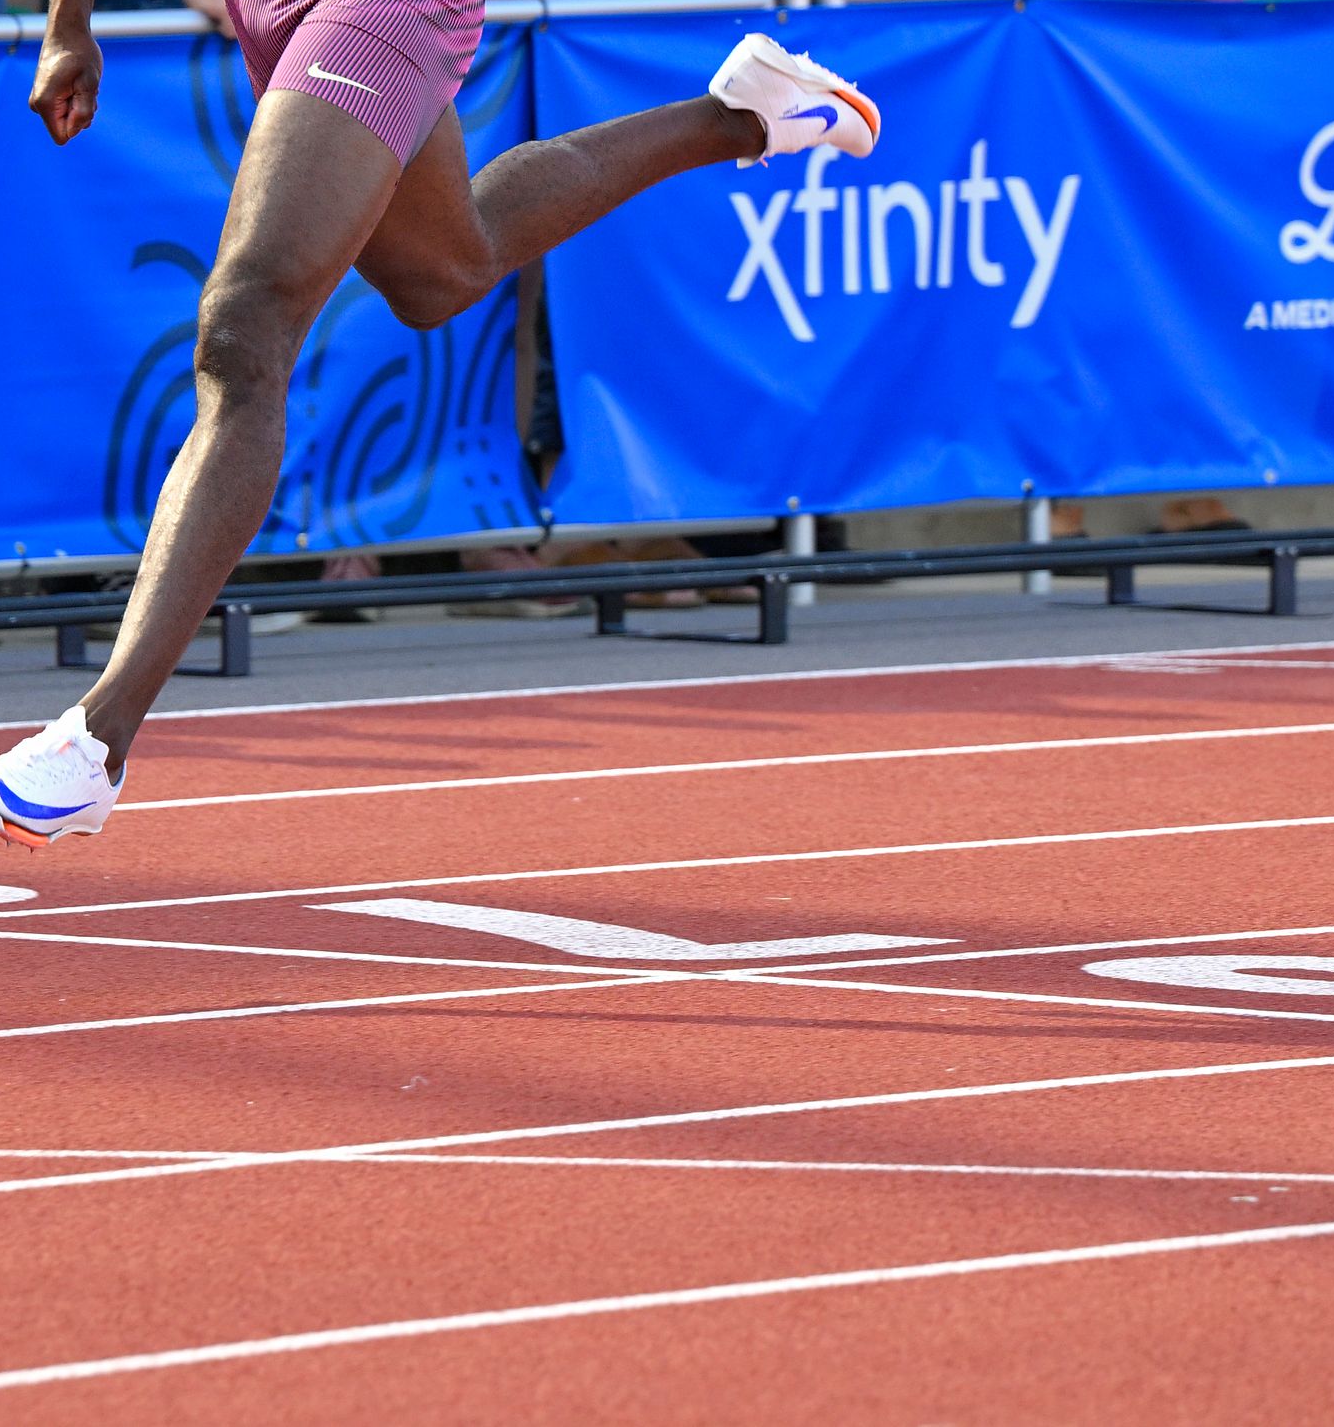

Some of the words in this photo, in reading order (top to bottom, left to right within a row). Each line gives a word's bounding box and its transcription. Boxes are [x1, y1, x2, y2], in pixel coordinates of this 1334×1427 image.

[726, 138, 1081, 342] xfinity
[1244, 301, 1268, 330] A
[302, 897, 968, 961] 7
